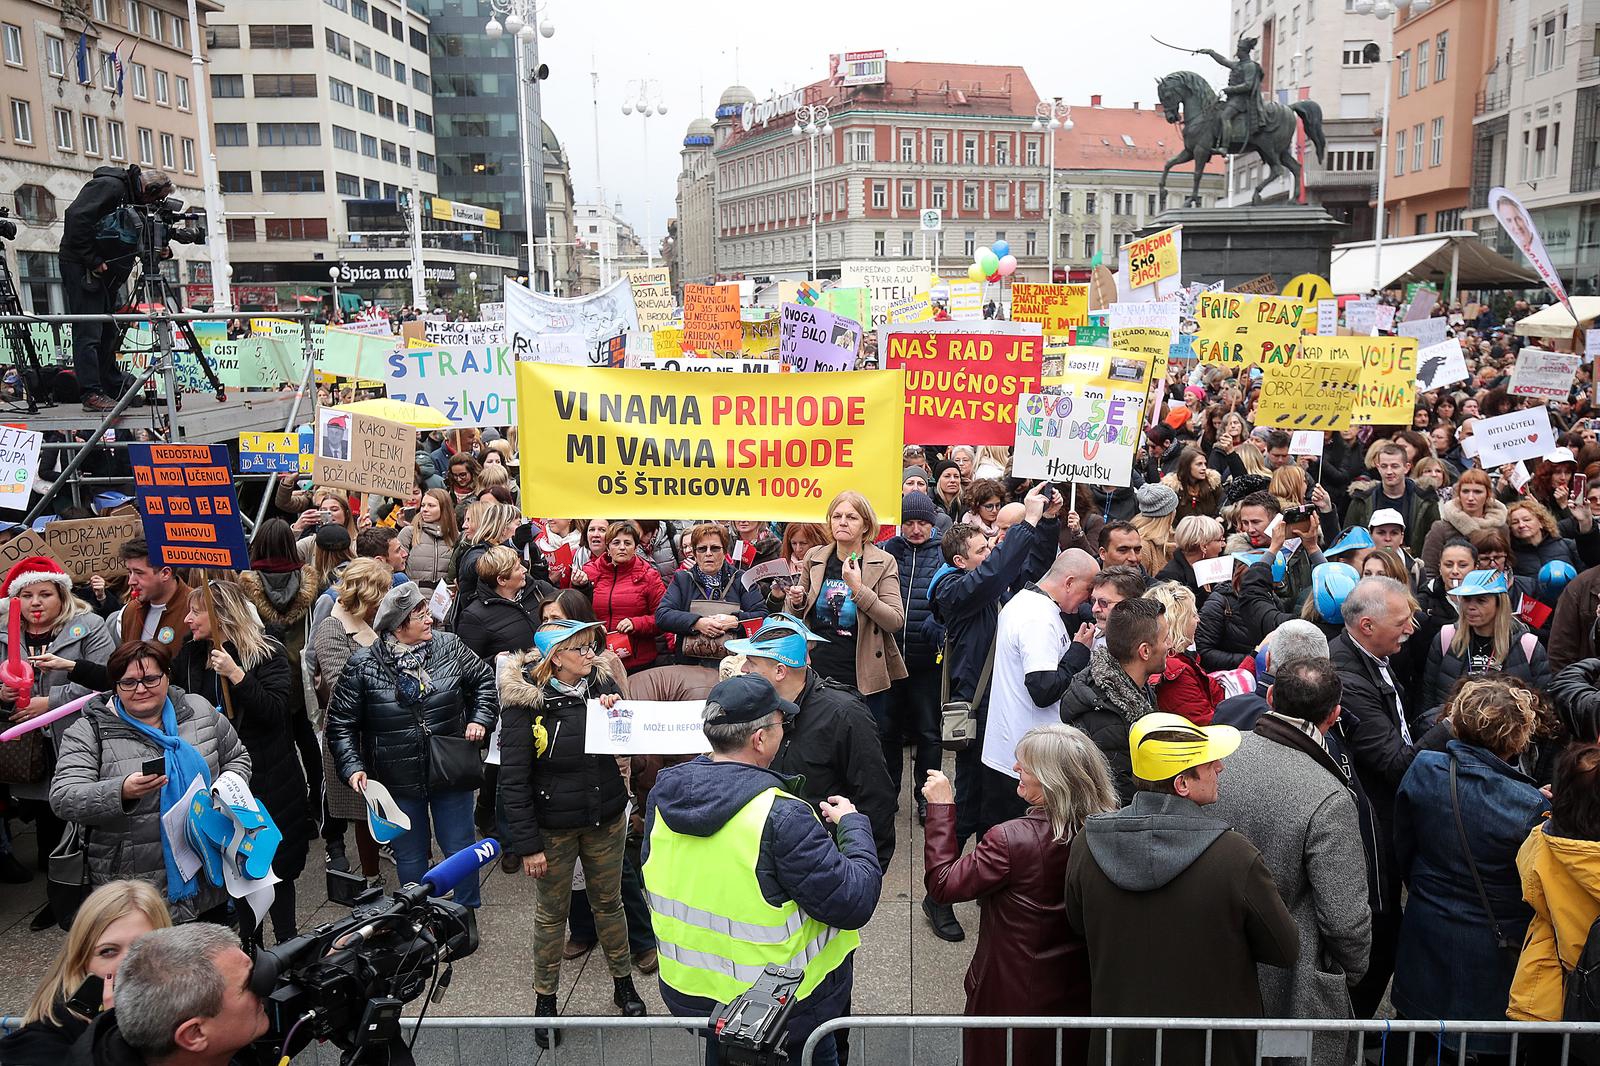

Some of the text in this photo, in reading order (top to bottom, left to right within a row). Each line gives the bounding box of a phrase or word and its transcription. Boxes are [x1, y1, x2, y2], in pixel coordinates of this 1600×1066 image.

[1130, 233, 1172, 259] ZAJEDNO
[897, 264, 930, 272] DRUŠTVO
[1131, 254, 1155, 272] SMO
[341, 263, 381, 282] Špica
[660, 287, 669, 296] JE
[685, 286, 729, 295] UZMITE MI
[686, 295, 727, 303] DNEVNICU
[1012, 284, 1031, 295] NIJE
[1033, 285, 1064, 296] ZNANJE
[636, 300, 672, 309] ARNEVALA
[715, 305, 739, 313] KUNA,
[1013, 304, 1049, 315] ZNANJE
[785, 307, 817, 324] OVOGA
[1258, 302, 1303, 327] PLAY
[425, 321, 465, 333] MI SMO
[684, 332, 721, 340] VRIJEDNO
[802, 326, 827, 344] BILO
[425, 333, 468, 345] SEKTOR!
[890, 334, 1034, 362] NAŠ RAD JE
[388, 346, 512, 378] ŠTRAJK
[1261, 341, 1297, 367] PAY
[1303, 347, 1322, 360] KAD
[1330, 347, 1349, 360] IMA
[1068, 361, 1099, 372] Kaos!!!
[1348, 367, 1361, 383] U
[905, 367, 1036, 396] UDUĆNOST
[444, 390, 516, 424] ŽIVOT
[554, 390, 865, 426] VI NAMA PRIHODE
[903, 395, 1018, 424] HRVATSK
[1026, 395, 1125, 425] OVO SE
[358, 420, 407, 441] KAKO JE
[1018, 417, 1043, 437] NE
[1047, 419, 1062, 438] BI
[1488, 419, 1535, 436] BITI UČITELJ
[364, 439, 403, 461] PLENKI
[566, 434, 853, 468] MI VAMA ISHODE
[1032, 440, 1099, 460] NI U
[1493, 437, 1527, 450] JE POZIV
[155, 449, 208, 459] NEDOSTAJU
[137, 469, 228, 482] MI MOJI UČENICI,
[362, 460, 407, 478] UKRAO
[1046, 458, 1112, 482] Hogwartsu
[323, 465, 412, 495] BOŽIĆNE PRAZNIKE
[598, 471, 823, 498] OŠ ŠTRIGOVA 100%
[149, 501, 228, 511] ALI OVO JE ZA
[50, 523, 134, 546] PODRŽAVAMO
[171, 528, 211, 537] NJIHOVU
[3, 537, 33, 561] DO
[70, 541, 112, 558] SVOJE
[167, 549, 227, 562] BUDUĆNOST!
[643, 722, 665, 732] MOŽE
[676, 723, 704, 731] REFOR
[474, 841, 495, 863] N1
